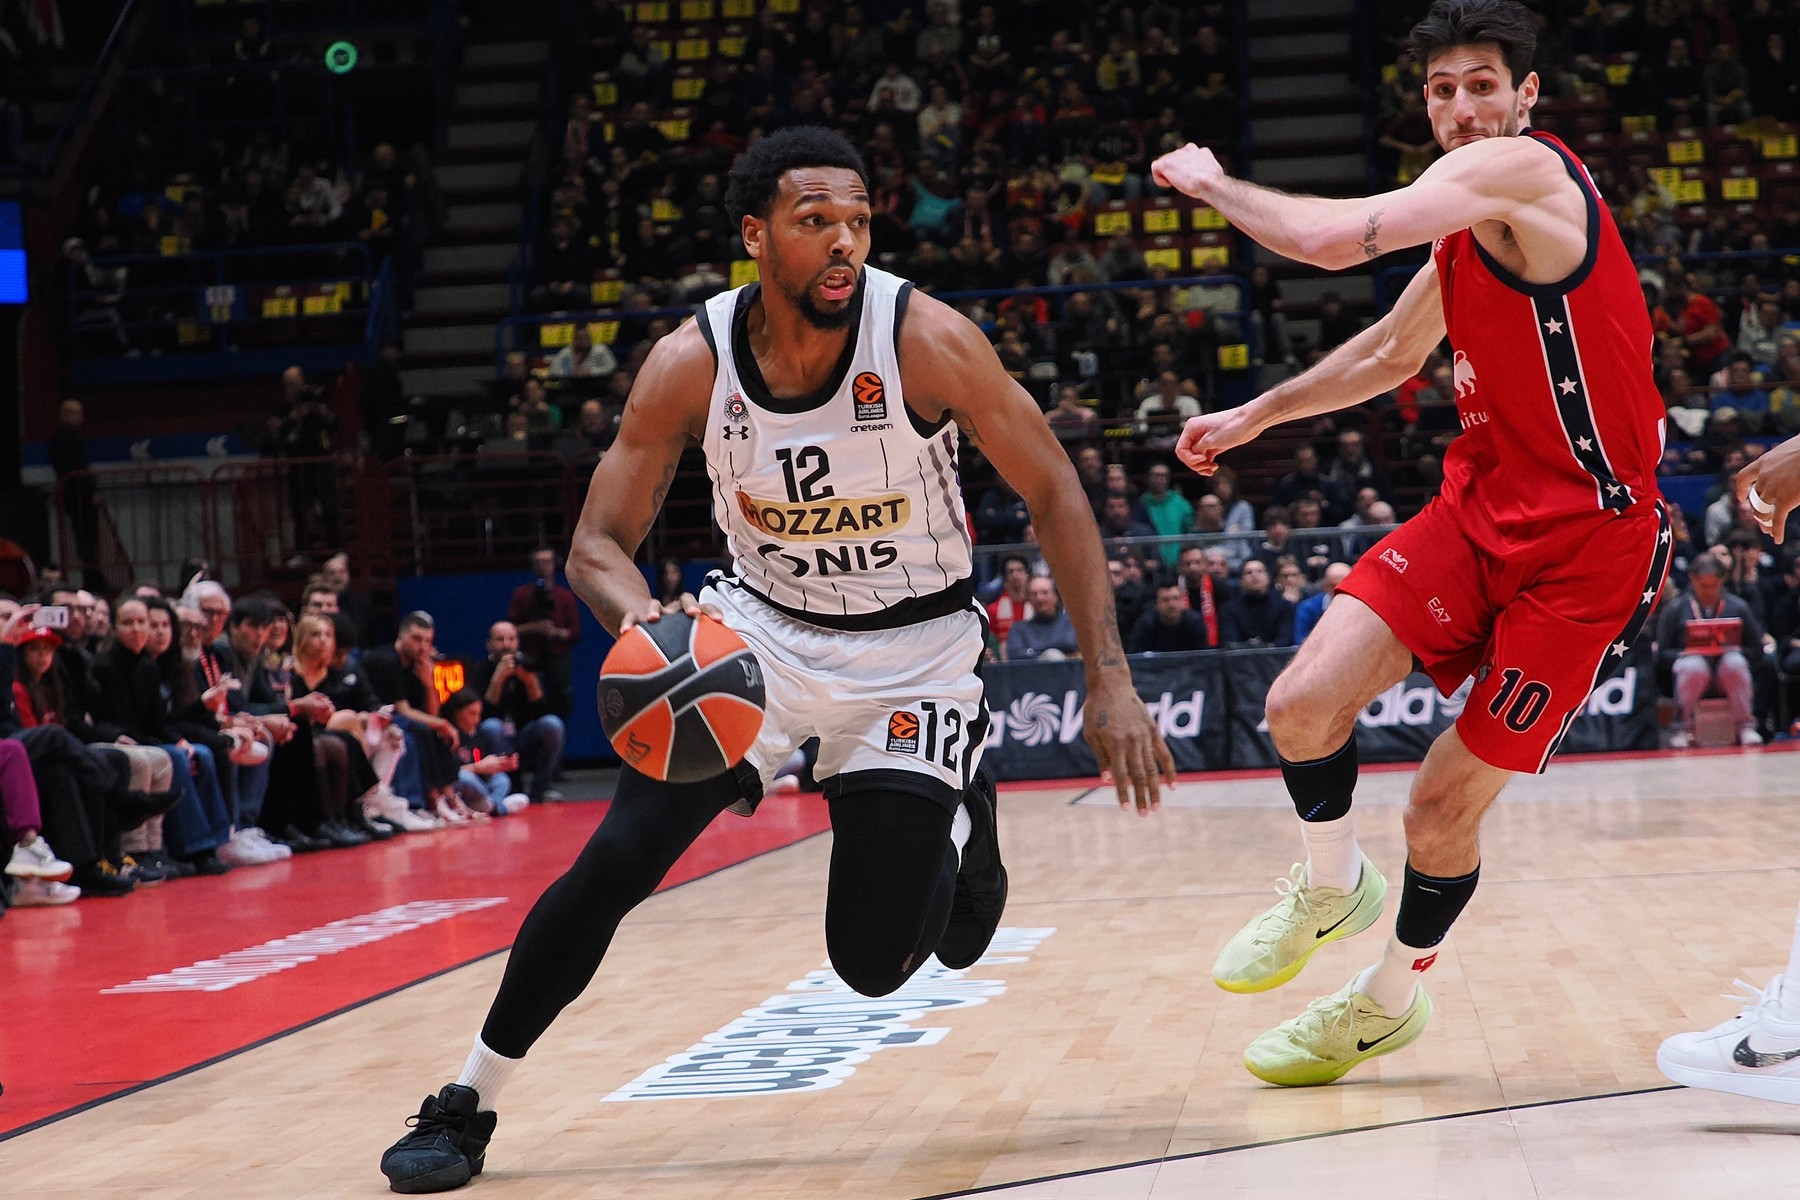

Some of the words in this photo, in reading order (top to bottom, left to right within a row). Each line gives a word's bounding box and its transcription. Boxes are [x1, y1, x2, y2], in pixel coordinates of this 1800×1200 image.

[857, 402, 884, 410] TURKISH
[850, 423, 894, 433] oneteam
[775, 445, 835, 503] 12
[739, 496, 906, 536] MOZZART
[815, 540, 898, 576] NIS
[1378, 555, 1405, 574] EYEWEAR
[1427, 596, 1452, 623] EA7
[1487, 667, 1552, 734] 10
[921, 701, 961, 774] 12
